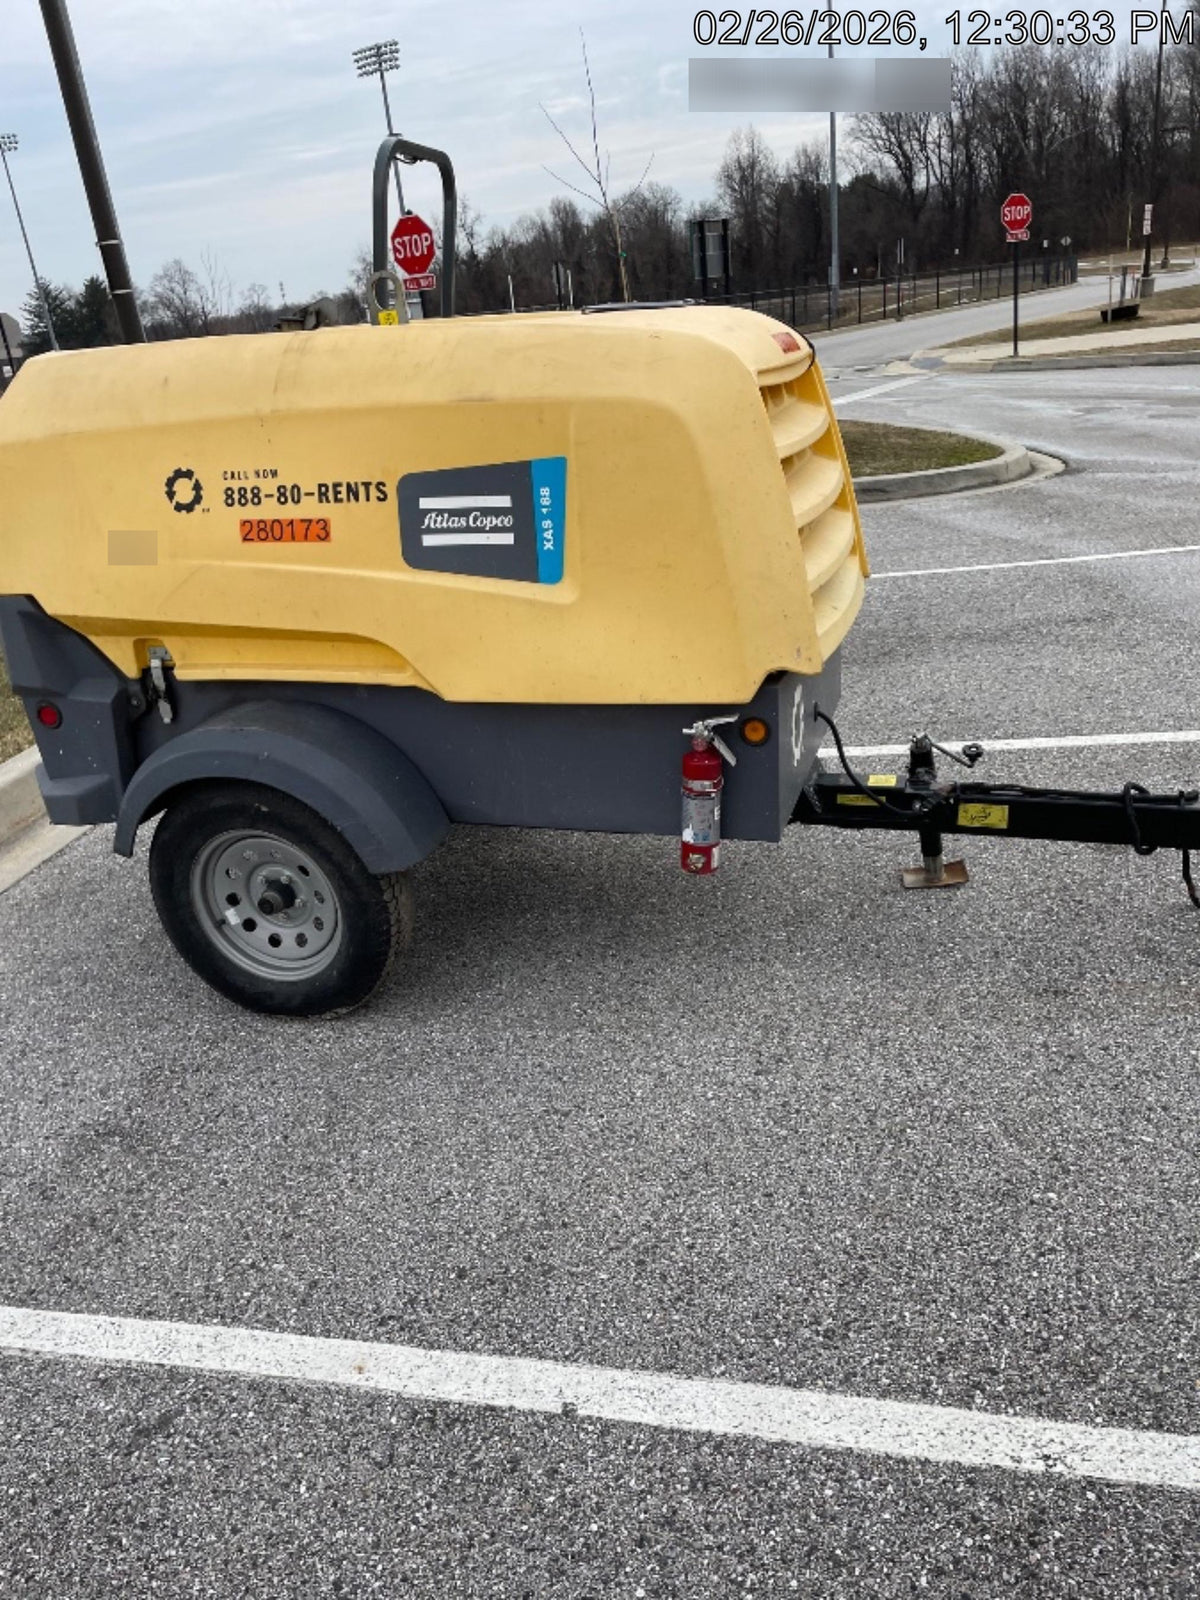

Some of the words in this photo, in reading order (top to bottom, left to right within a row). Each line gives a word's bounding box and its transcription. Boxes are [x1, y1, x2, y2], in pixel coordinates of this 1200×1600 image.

[1003, 205, 1031, 221] STOP
[394, 232, 431, 259] STOP
[222, 470, 249, 481] CALL
[254, 468, 278, 479] NOW
[223, 481, 388, 507] 888-80-RENTS
[241, 518, 330, 541] 280173
[421, 511, 467, 529] Atlas
[468, 511, 514, 531] Copco
[541, 519, 554, 551] XAS
